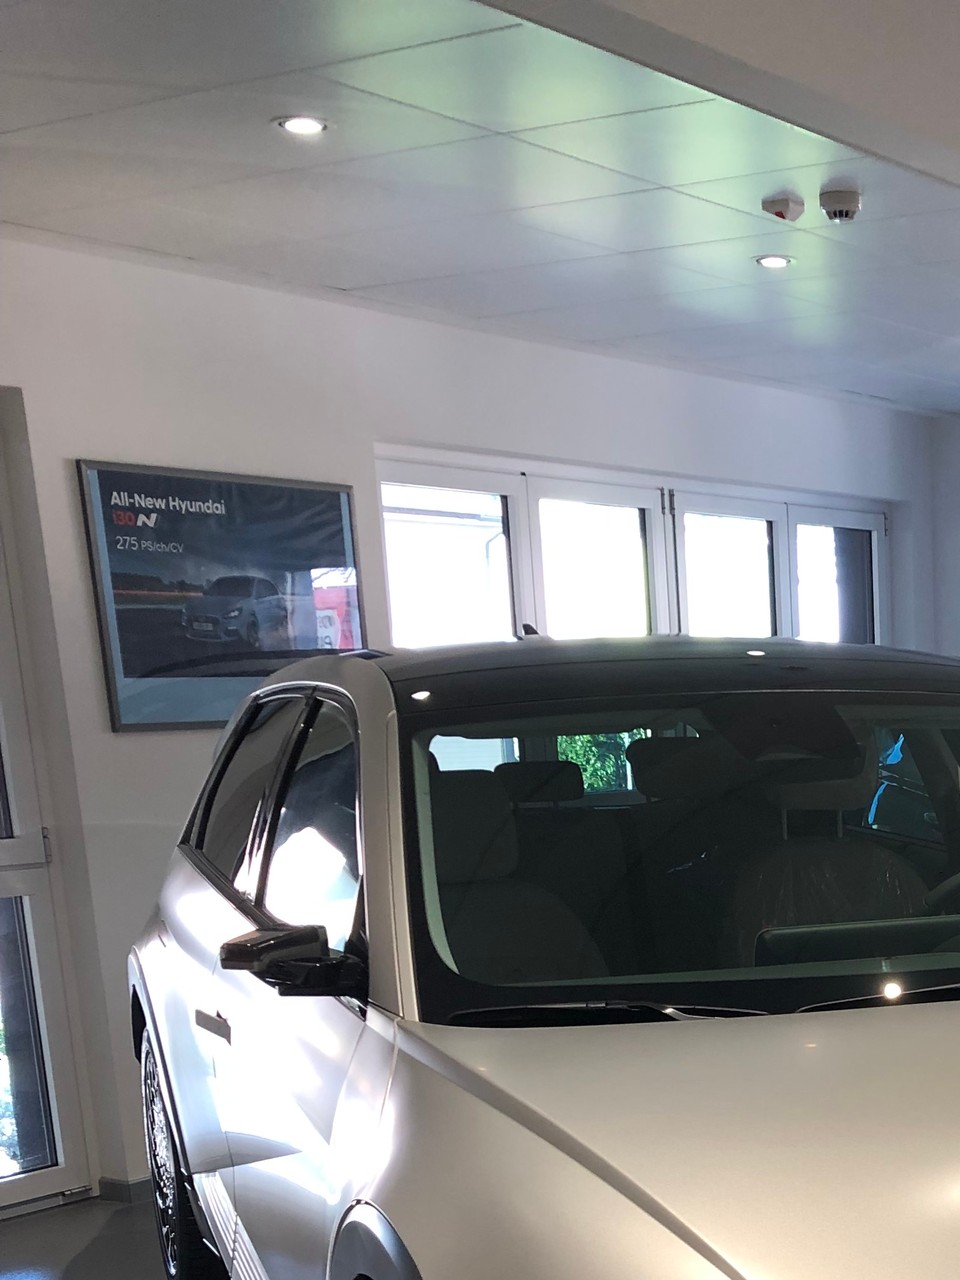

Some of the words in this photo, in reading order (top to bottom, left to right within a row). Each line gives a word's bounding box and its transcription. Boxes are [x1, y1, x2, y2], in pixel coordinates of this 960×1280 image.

[111, 491, 166, 510] All-New
[168, 496, 226, 515] Hyundai
[136, 512, 158, 528] N
[116, 535, 139, 551] 275
